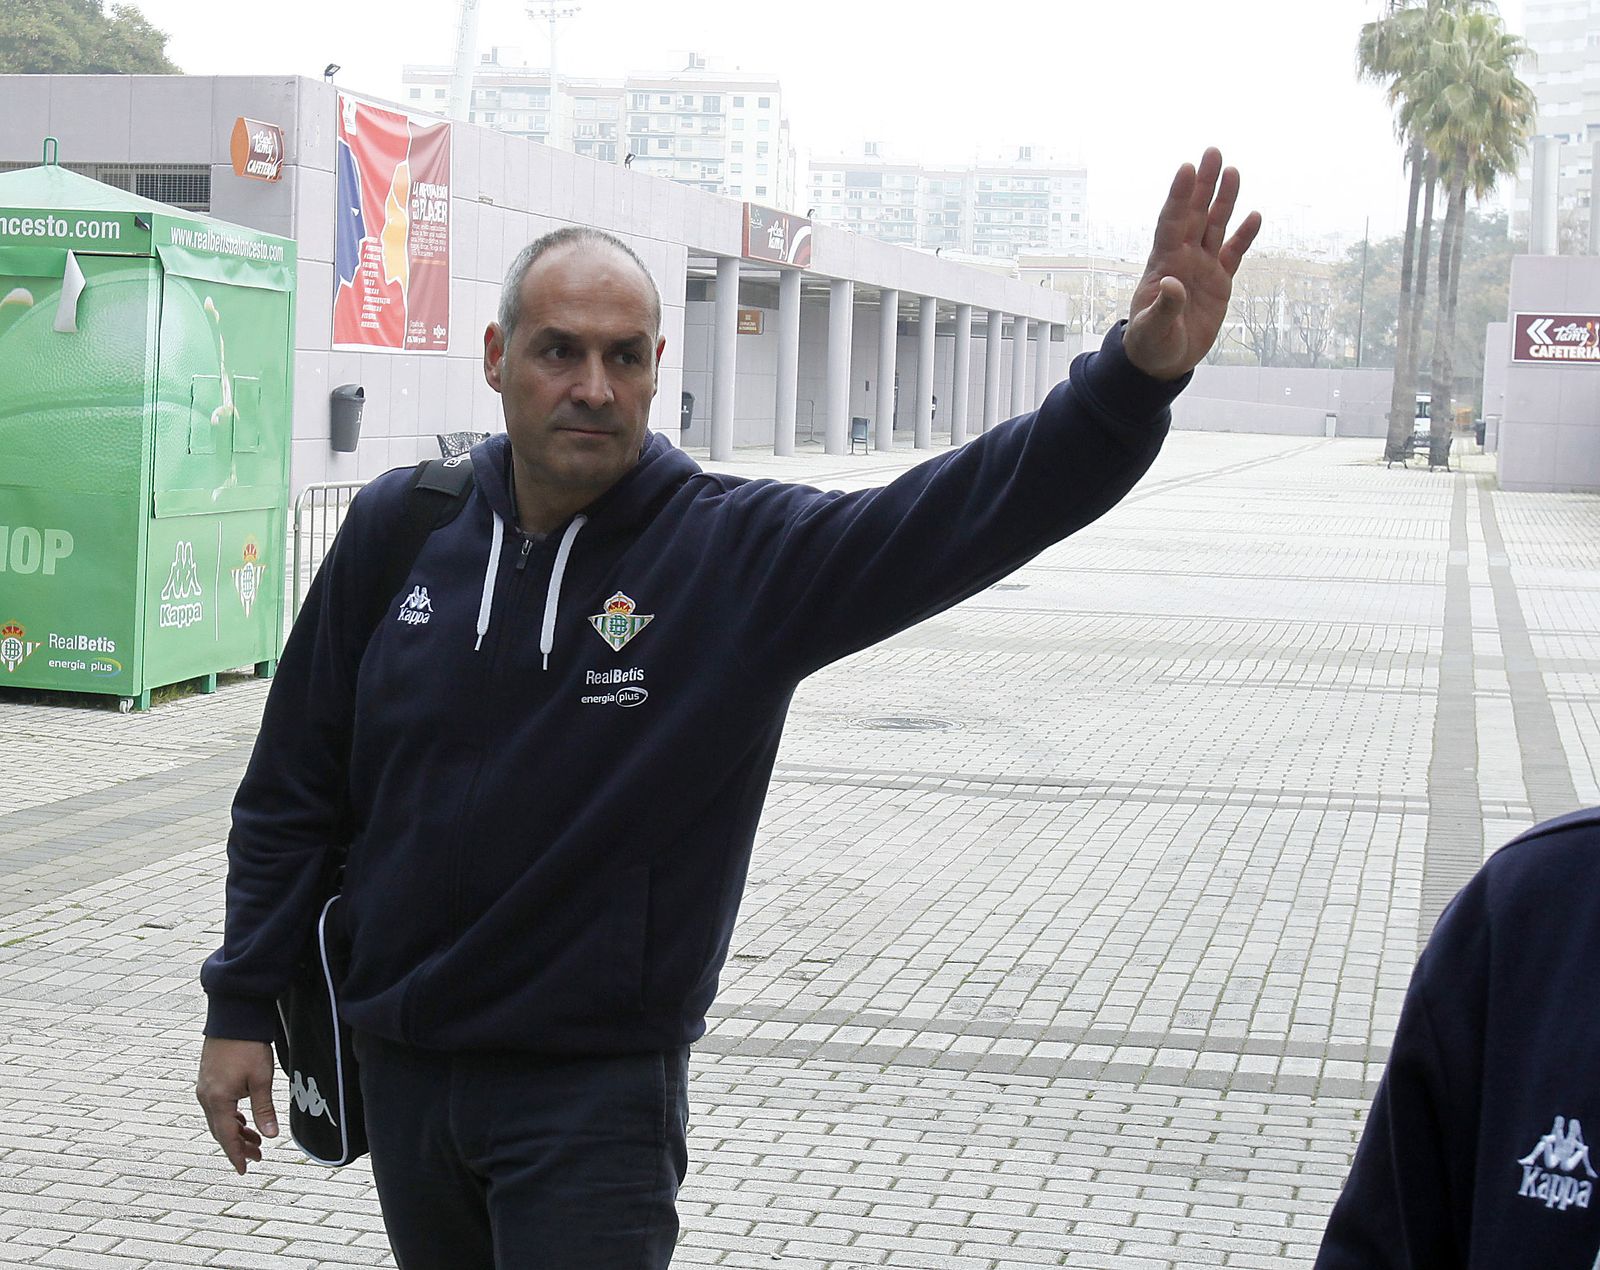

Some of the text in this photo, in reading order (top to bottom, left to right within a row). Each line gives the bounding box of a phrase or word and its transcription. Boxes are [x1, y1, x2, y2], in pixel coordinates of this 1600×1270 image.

[170, 226, 284, 262] www.realbetisbaloncesto.com
[1529, 344, 1600, 359] CAFETERIA
[159, 602, 202, 628] Kappa
[397, 607, 430, 625] Kappa
[49, 633, 116, 652] RealBetis
[90, 661, 113, 672] plus
[586, 667, 645, 685] RealBetis
[619, 692, 640, 703] plus
[1517, 1165, 1593, 1211] Kappa
